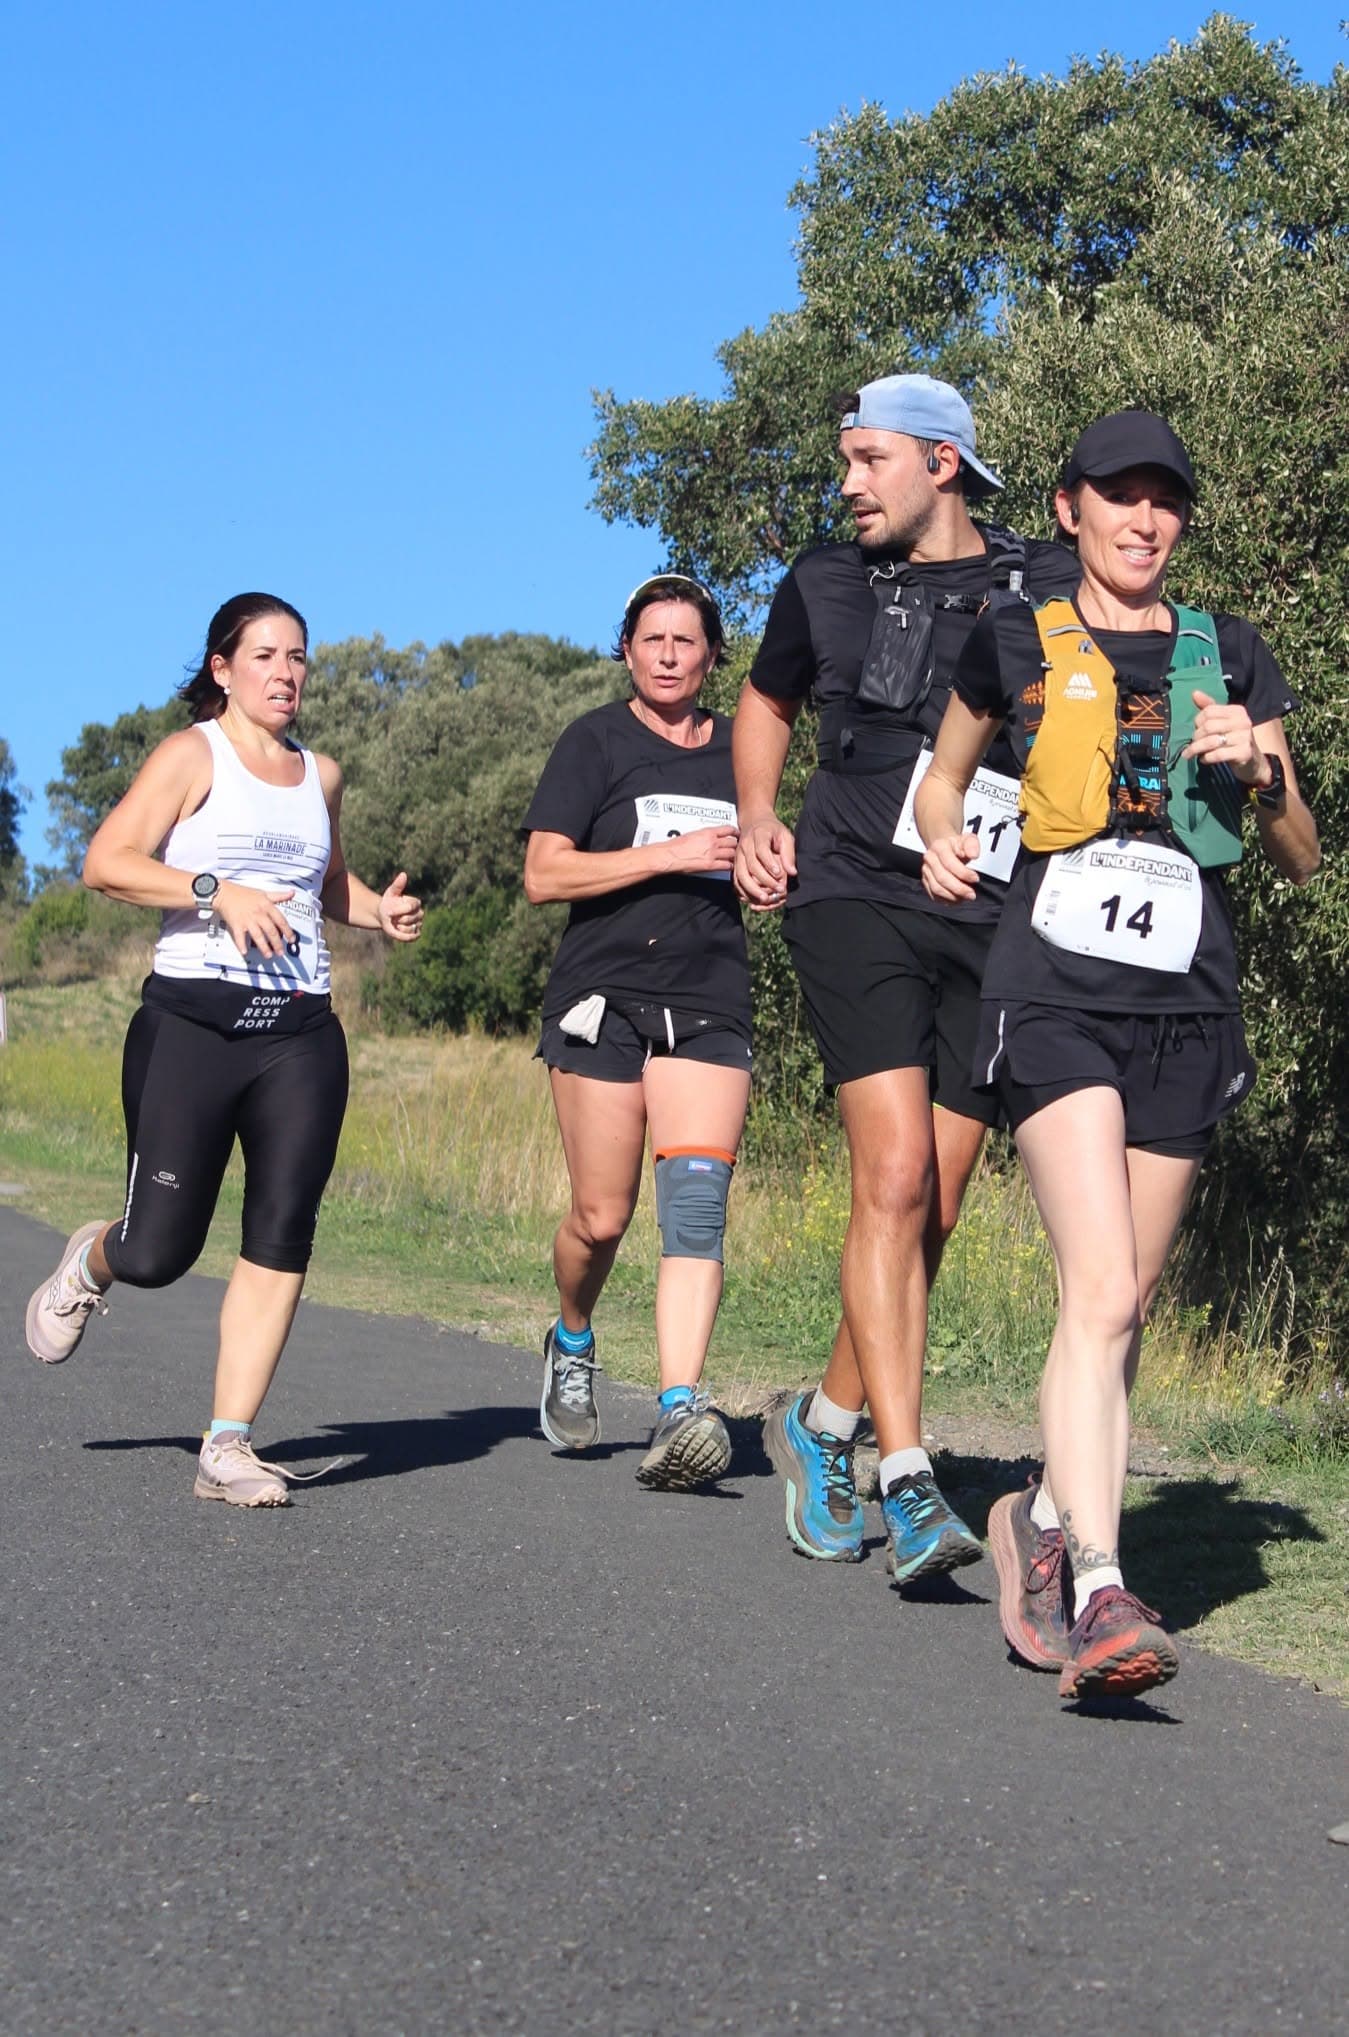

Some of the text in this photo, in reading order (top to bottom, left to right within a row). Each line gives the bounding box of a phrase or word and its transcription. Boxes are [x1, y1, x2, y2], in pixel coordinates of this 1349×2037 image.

[966, 814, 1007, 853] 11
[255, 838, 305, 854] LA MARINADE
[1090, 852, 1192, 882] L'INDEPENDANT
[1100, 894, 1154, 939] 14
[233, 1019, 276, 1029] PORT
[243, 1008, 280, 1017] RESS
